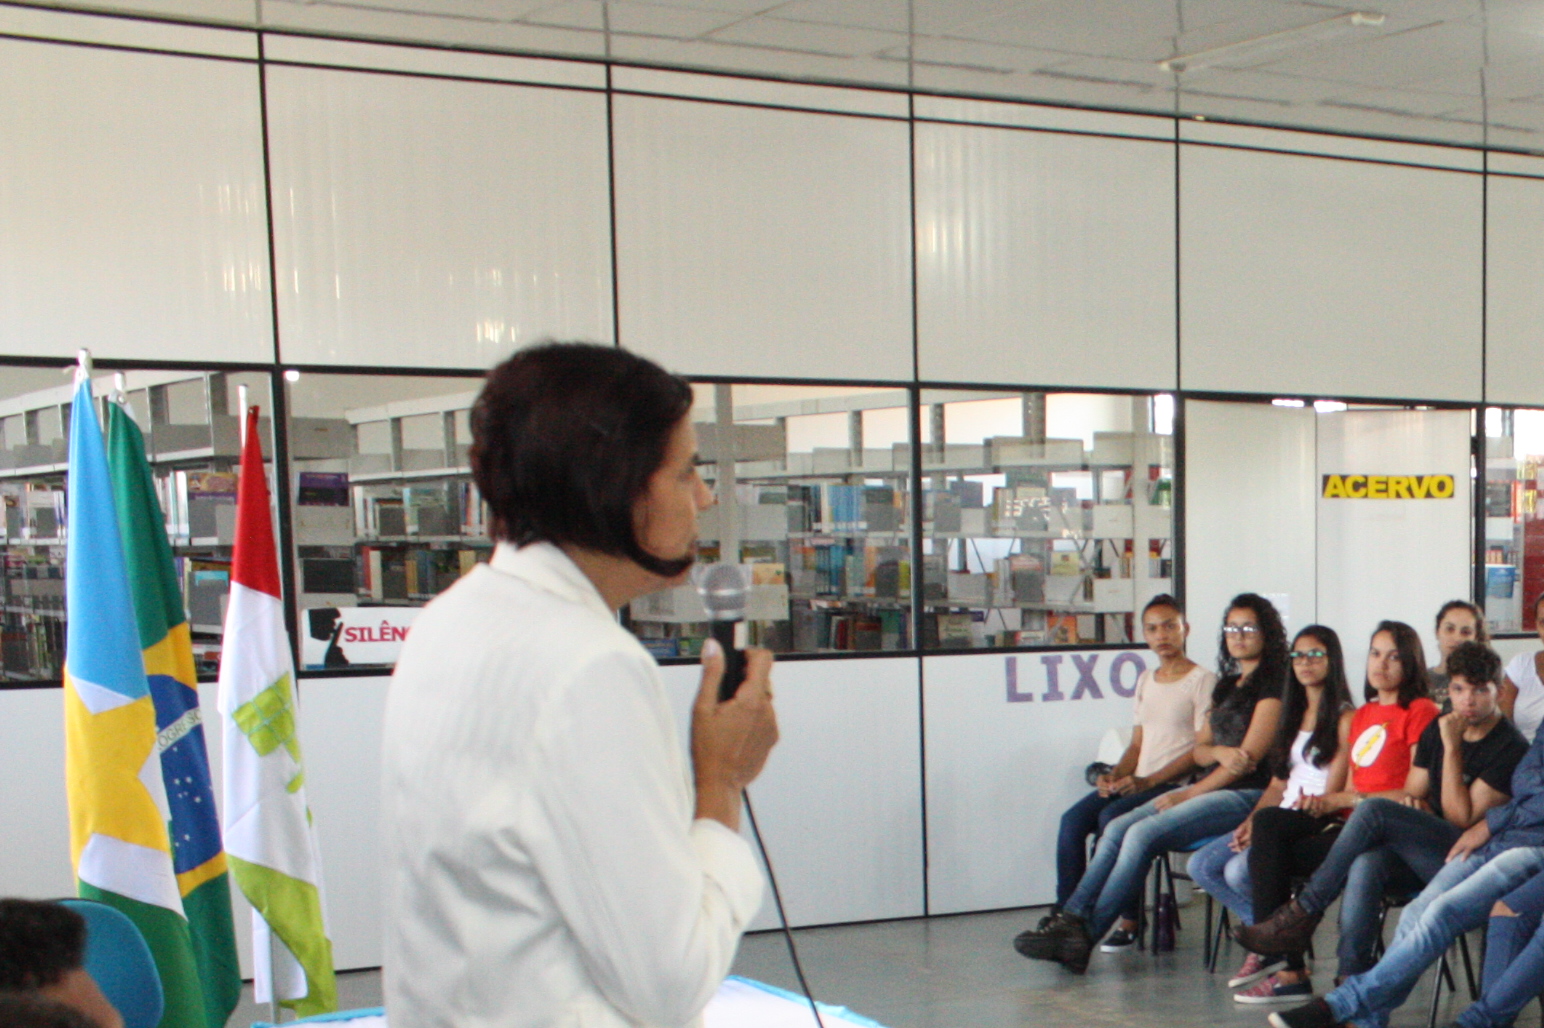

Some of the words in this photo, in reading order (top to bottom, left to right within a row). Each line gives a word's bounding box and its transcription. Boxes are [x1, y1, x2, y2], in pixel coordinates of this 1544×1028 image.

[1323, 474, 1454, 499] ACERVO
[344, 619, 411, 642] SILÊN
[1005, 651, 1147, 702] LIXO
